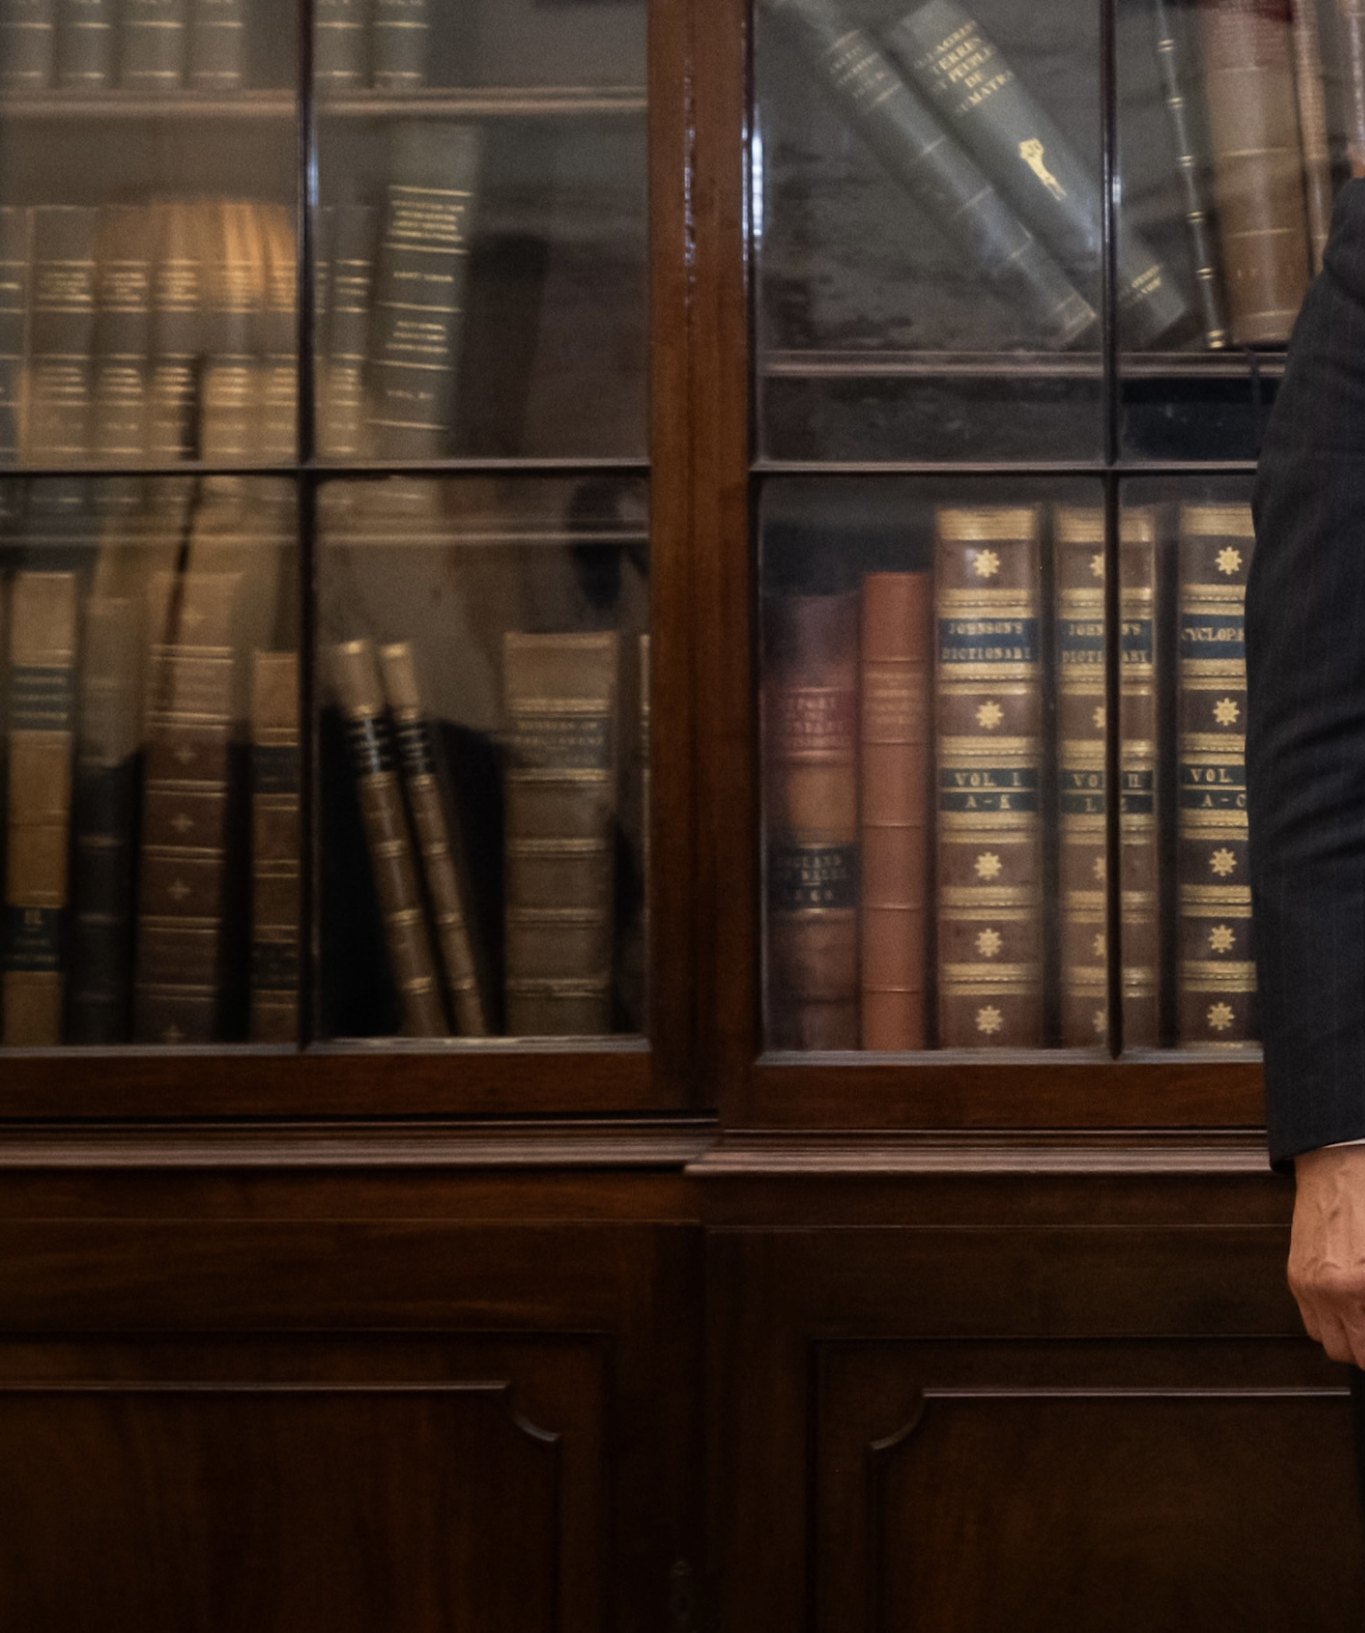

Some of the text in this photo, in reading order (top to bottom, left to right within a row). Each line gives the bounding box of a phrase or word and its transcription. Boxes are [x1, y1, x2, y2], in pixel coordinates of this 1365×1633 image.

[949, 622, 1024, 636] JOHNSON'S
[942, 646, 1032, 661] DICTIONARY
[1012, 772, 1022, 786] I
